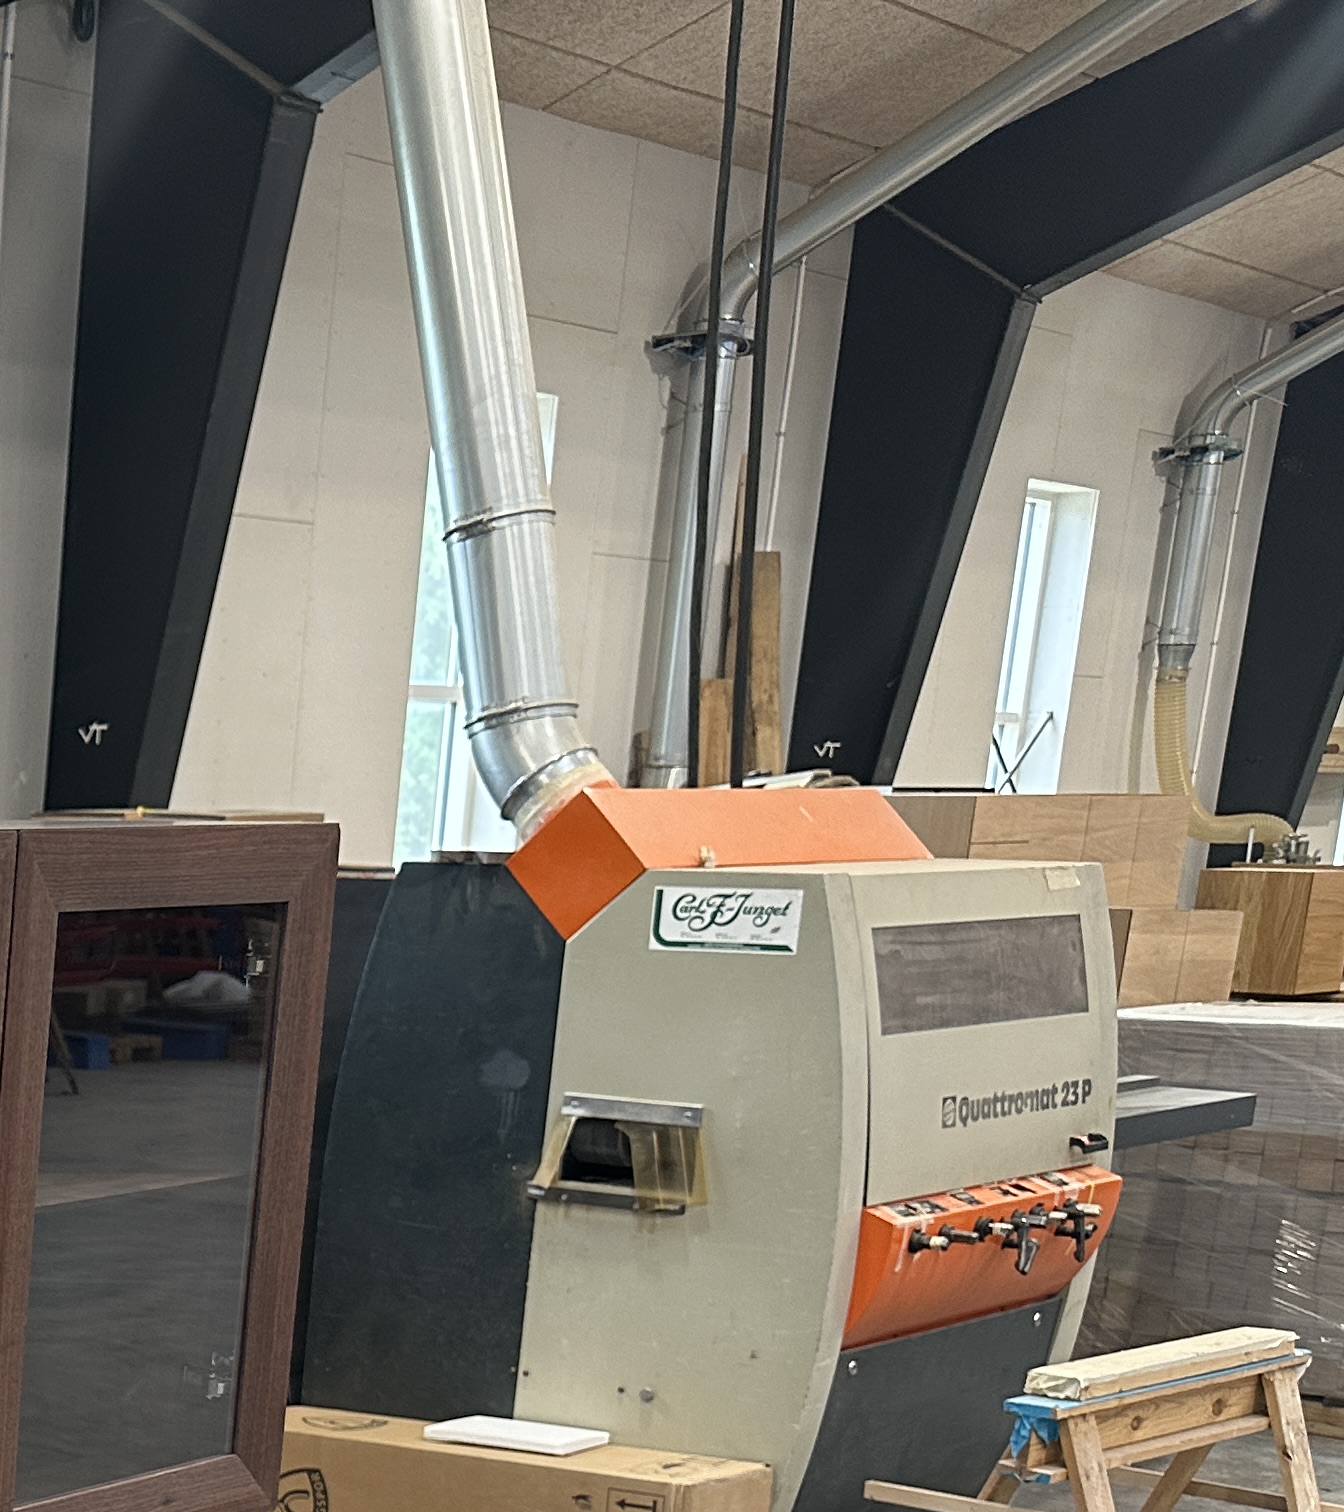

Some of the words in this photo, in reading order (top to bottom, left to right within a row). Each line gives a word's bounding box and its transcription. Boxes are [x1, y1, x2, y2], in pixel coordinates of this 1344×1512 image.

[958, 1083, 1058, 1127] Quattromat
[1061, 1080, 1079, 1107] 23
[1082, 1079, 1092, 1104] P
